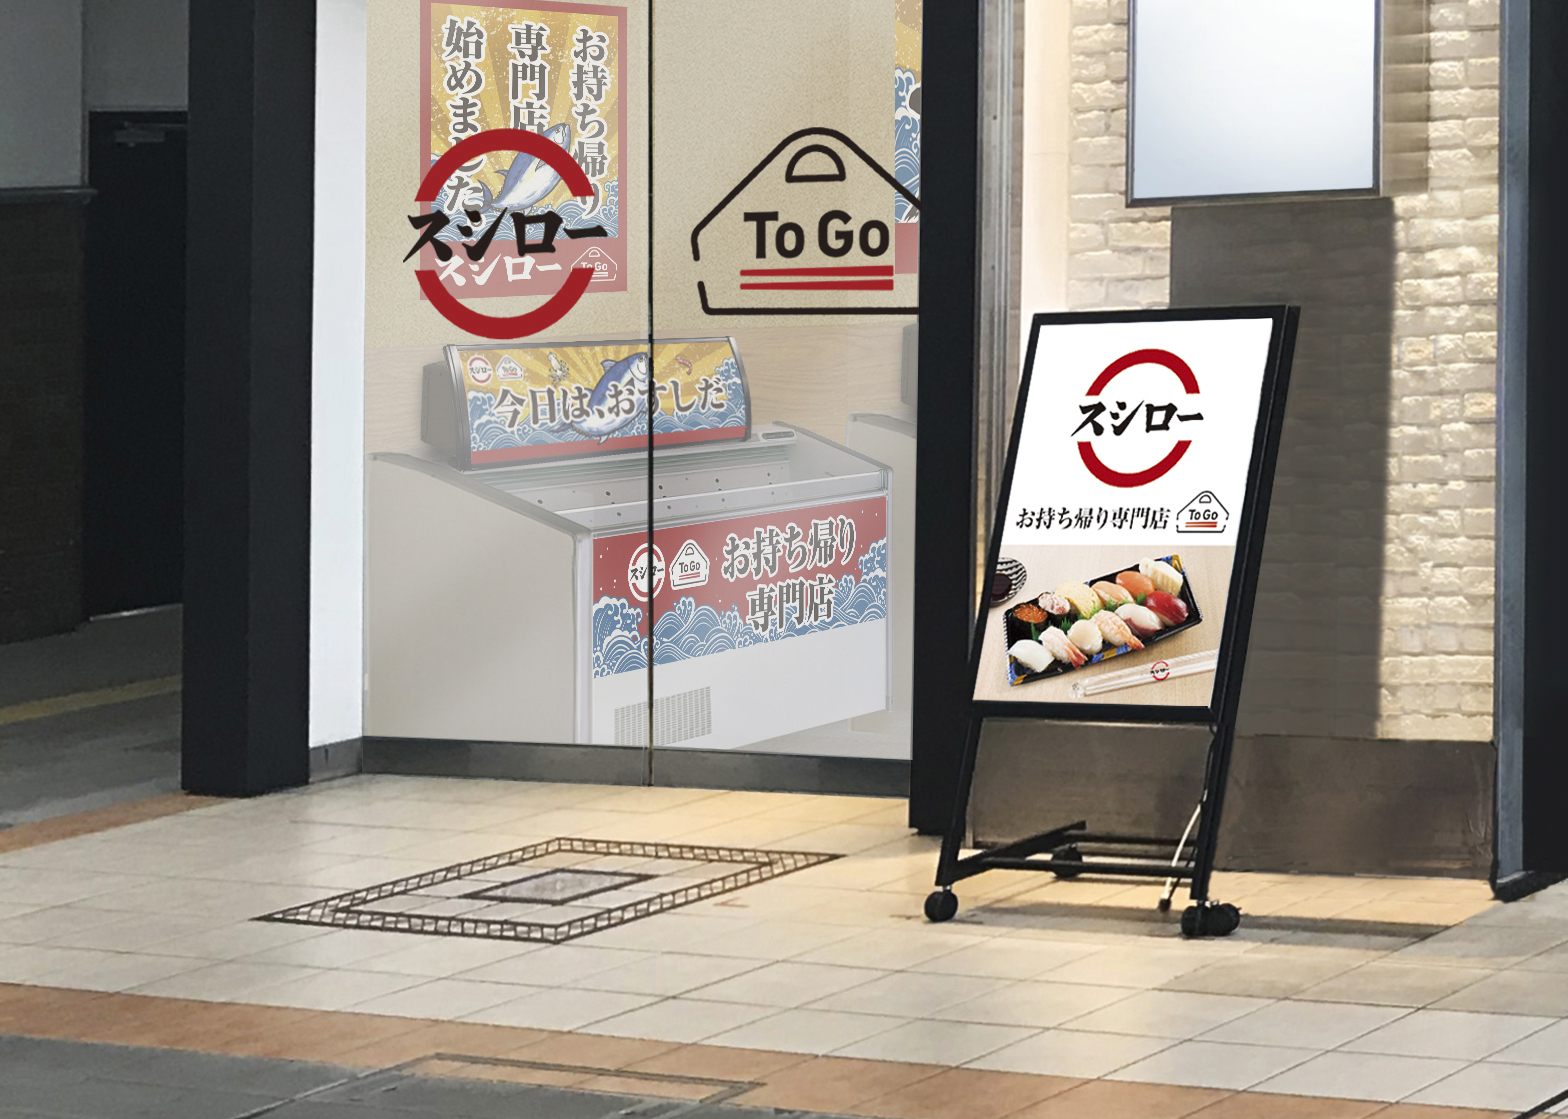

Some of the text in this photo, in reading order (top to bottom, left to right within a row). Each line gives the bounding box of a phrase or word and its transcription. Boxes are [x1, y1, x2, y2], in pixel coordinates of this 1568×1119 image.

[402, 207, 608, 263] スシロー
[743, 210, 891, 259] To Go
[435, 253, 562, 286] スシロー
[1071, 399, 1204, 437] スシロー
[1015, 506, 1171, 531] お持ち帰り専門店
[723, 517, 856, 580] お持ち帰り
[747, 576, 836, 632] 専門店
